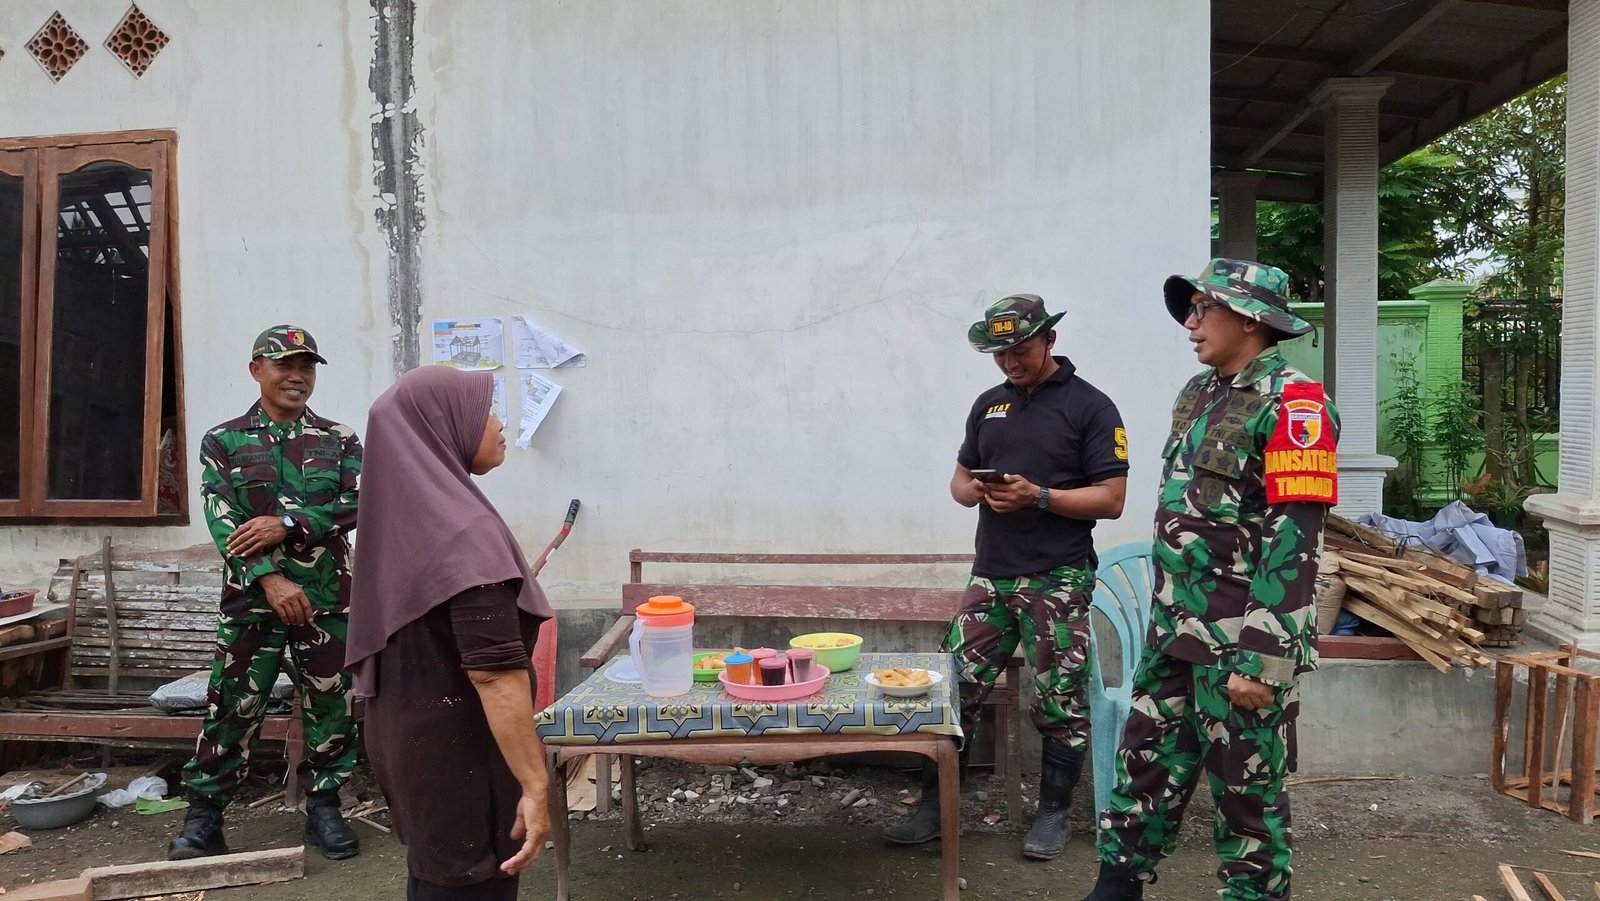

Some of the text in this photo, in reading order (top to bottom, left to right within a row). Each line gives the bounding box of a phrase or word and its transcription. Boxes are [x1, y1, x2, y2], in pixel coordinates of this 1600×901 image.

[994, 321, 1012, 333] TNI-AD
[987, 403, 1010, 414] STAF
[1275, 476, 1333, 497] TMMD
